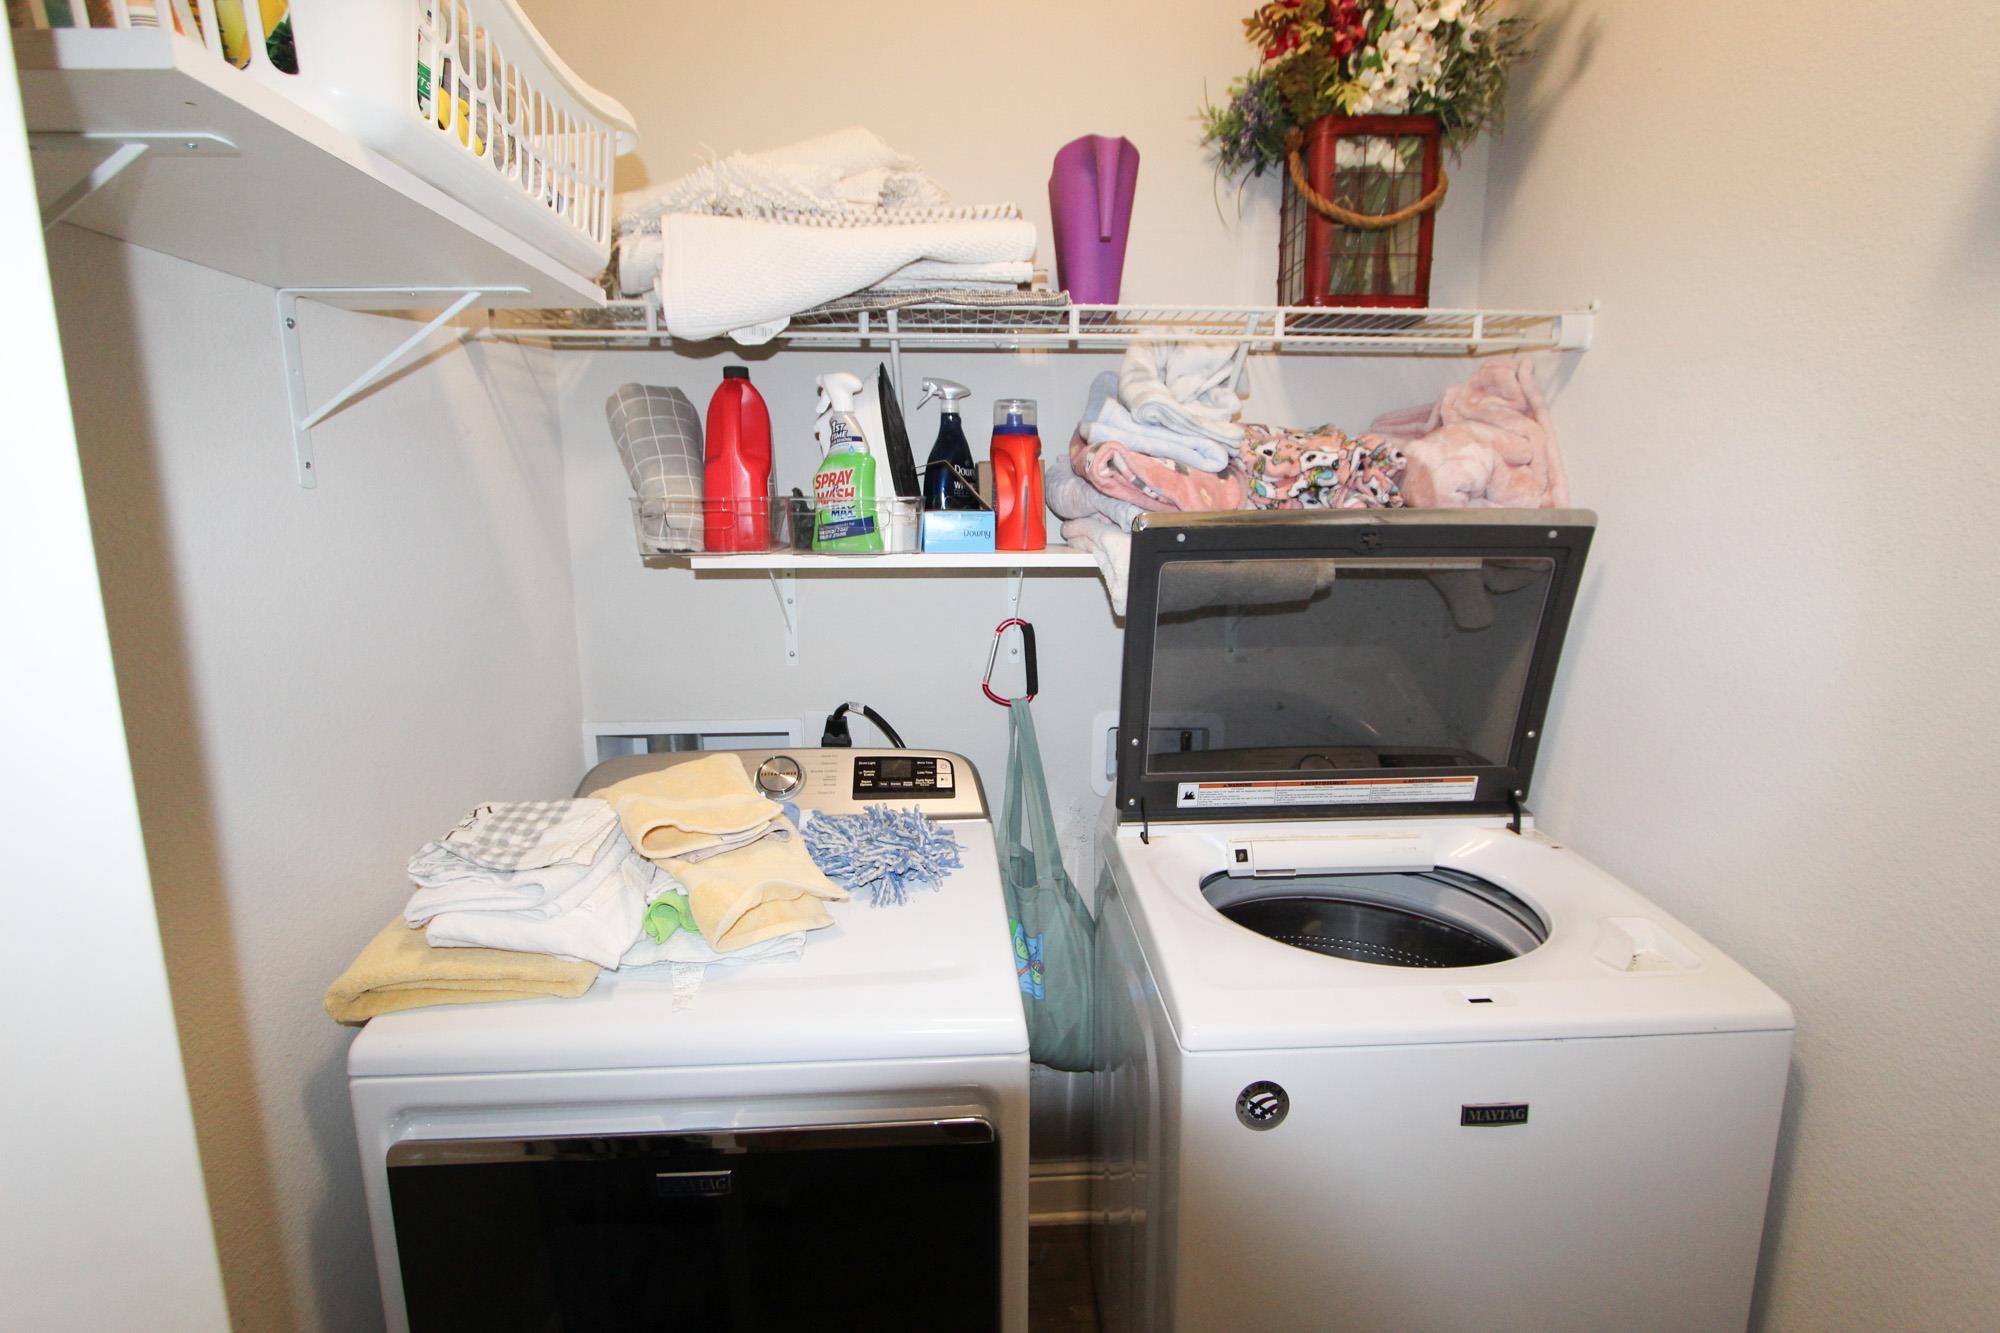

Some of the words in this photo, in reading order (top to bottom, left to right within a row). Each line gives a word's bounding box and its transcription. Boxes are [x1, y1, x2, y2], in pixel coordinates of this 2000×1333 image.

[832, 421, 845, 432] 1ST
[832, 431, 847, 441] TIME
[815, 469, 854, 490] SPRAY
[816, 487, 855, 505] WASH
[1467, 1108, 1525, 1121] MAYTAG
